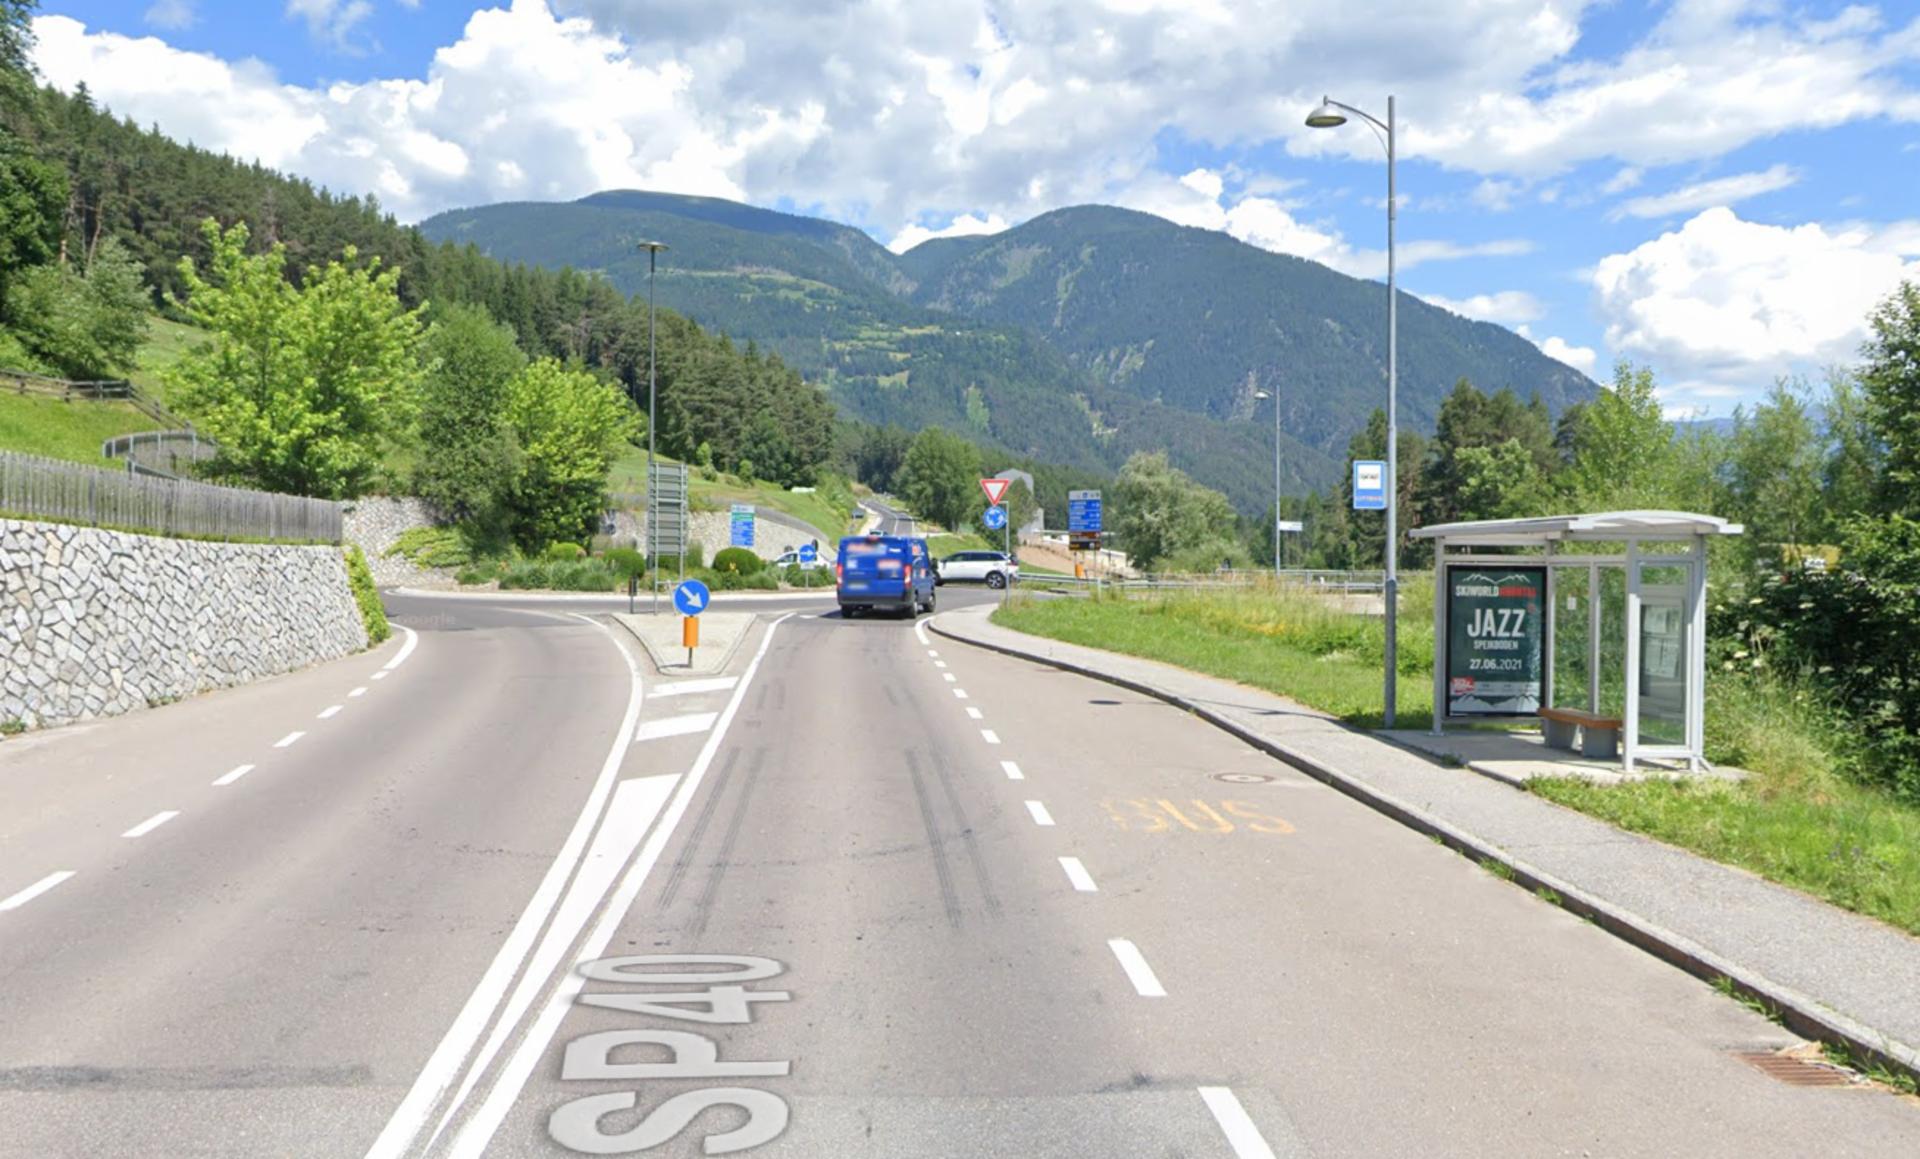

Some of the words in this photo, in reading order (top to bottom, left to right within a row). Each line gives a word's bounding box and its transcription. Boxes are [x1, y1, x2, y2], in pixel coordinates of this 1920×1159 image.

[1467, 608, 1526, 638] JAZZ
[1469, 658, 1523, 670] 27.06.2021
[1100, 797, 1295, 834] BUS
